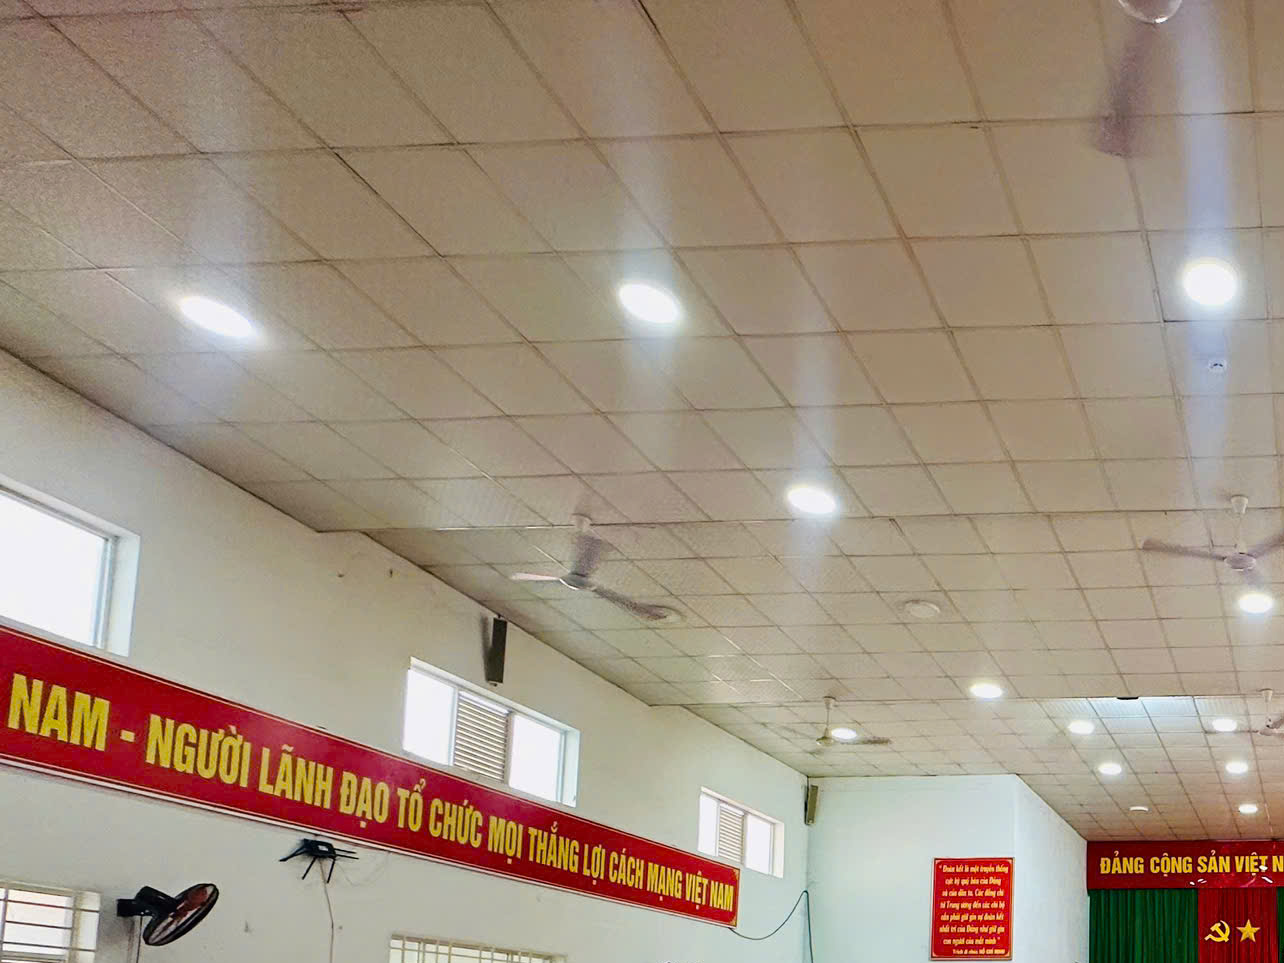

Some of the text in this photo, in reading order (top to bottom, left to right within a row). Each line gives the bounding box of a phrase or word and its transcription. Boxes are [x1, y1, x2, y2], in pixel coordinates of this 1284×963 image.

[8, 673, 734, 911] NAM - NGƯỜI LÃNH ĐẠO TỔ CHỨC MỌI THẮNG LỢI CÁCH MẠNG VIỆT NAM
[1100, 850, 1144, 874] ĐẢNG
[1150, 853, 1192, 877] CỘNG
[1197, 850, 1230, 872] SẢN
[1234, 852, 1268, 876] VIỆT
